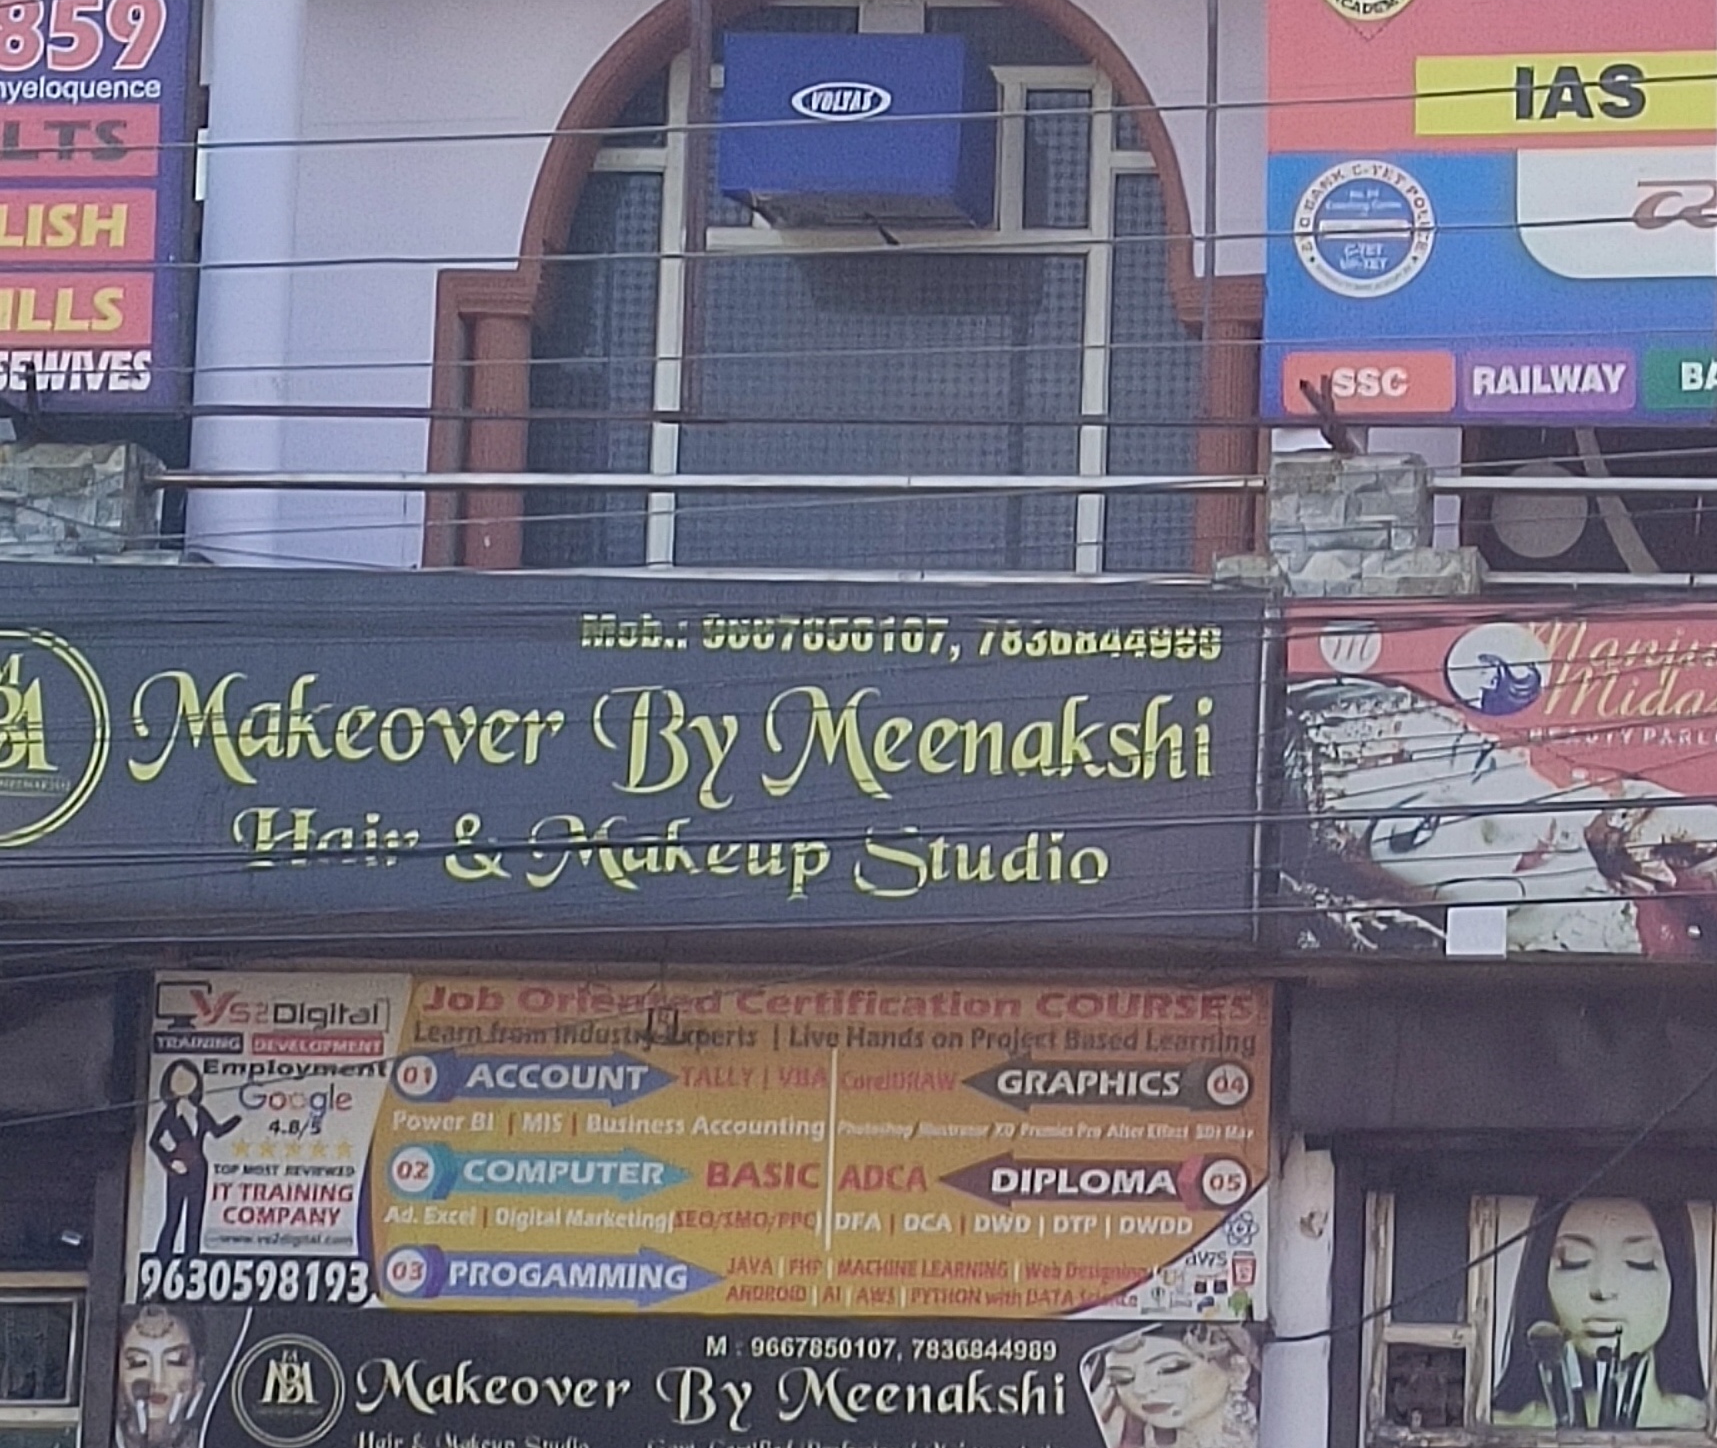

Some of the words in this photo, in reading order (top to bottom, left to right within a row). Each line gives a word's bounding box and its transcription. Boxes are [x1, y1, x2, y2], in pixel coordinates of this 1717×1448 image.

[810, 90, 871, 112] VOLTAS
[1515, 65, 1647, 121] IAS
[1332, 370, 1408, 397] SSC
[1473, 365, 1627, 396] RAILWAY
[128, 669, 565, 785] Makeover
[593, 685, 739, 809] By
[761, 686, 1215, 799] Meenakshi
[233, 807, 421, 869] Hair
[444, 813, 512, 882] &
[525, 814, 831, 901] Makeup
[854, 826, 1109, 898] Studio
[273, 1001, 379, 1031] Digital
[422, 985, 505, 1013] Job
[517, 983, 722, 1016] Oriented
[736, 987, 1023, 1020] Certification
[1035, 992, 1255, 1021] COURSES
[156, 1034, 241, 1050] TRAINING
[254, 1035, 382, 1053] DEVELOPMENT
[414, 1022, 480, 1045] Learn
[789, 1026, 840, 1048] Live
[846, 1027, 925, 1049] Hands
[932, 1031, 965, 1050] on
[975, 1029, 1057, 1054] Project
[1064, 1029, 1139, 1052] Based
[1145, 1029, 1257, 1056] Learning
[203, 1058, 387, 1080] Employment
[403, 1066, 433, 1085] 01
[466, 1064, 649, 1092] ACCOUNT
[681, 1064, 752, 1088] TALLY
[996, 1068, 1182, 1098] GRAPHICS
[1212, 1073, 1245, 1096] 04
[239, 1083, 353, 1112] Google
[268, 1118, 323, 1141] 4.8/5
[392, 1110, 464, 1134] Power
[470, 1111, 494, 1132] BI
[521, 1112, 564, 1134] MIS
[586, 1114, 686, 1137] Business
[692, 1115, 826, 1142] Accounting
[212, 1163, 240, 1175] TOP
[241, 1163, 279, 1176] MOST
[396, 1159, 431, 1179] 02
[462, 1157, 665, 1186] COMPUTER
[705, 1161, 821, 1190] BASIC
[837, 1163, 928, 1192] ADCA
[990, 1166, 1178, 1196] DIPLOMA
[1208, 1171, 1241, 1193] 05
[211, 1182, 237, 1201] IT
[240, 1181, 354, 1203] TRAINING
[222, 1206, 342, 1227] COMPANY
[383, 1205, 418, 1225] Ad.
[424, 1206, 477, 1226] Excel
[495, 1208, 561, 1232] Digital
[835, 1211, 882, 1233] DFA
[903, 1212, 953, 1234] DCA
[973, 1213, 1032, 1234] DWD
[1052, 1214, 1098, 1235] DTP
[1118, 1214, 1194, 1236] DWDD
[140, 1259, 370, 1303] 9630598193
[391, 1262, 422, 1282] 03
[448, 1261, 688, 1292] PROGAMMING
[727, 1257, 774, 1276] JAVA
[788, 1257, 822, 1277] PHP
[837, 1258, 917, 1278] MACHINE
[921, 1259, 1009, 1280] LEARNING
[726, 1284, 807, 1303] ANDROID
[822, 1285, 842, 1303] AI
[911, 1286, 982, 1306] PYTHON
[1025, 1289, 1074, 1308] DATA
[750, 1336, 903, 1363] 9667850107,
[911, 1336, 1058, 1362] 7836844989
[355, 1357, 632, 1416] Makeover
[656, 1363, 754, 1433] By
[778, 1364, 1067, 1424] Meenakshi
